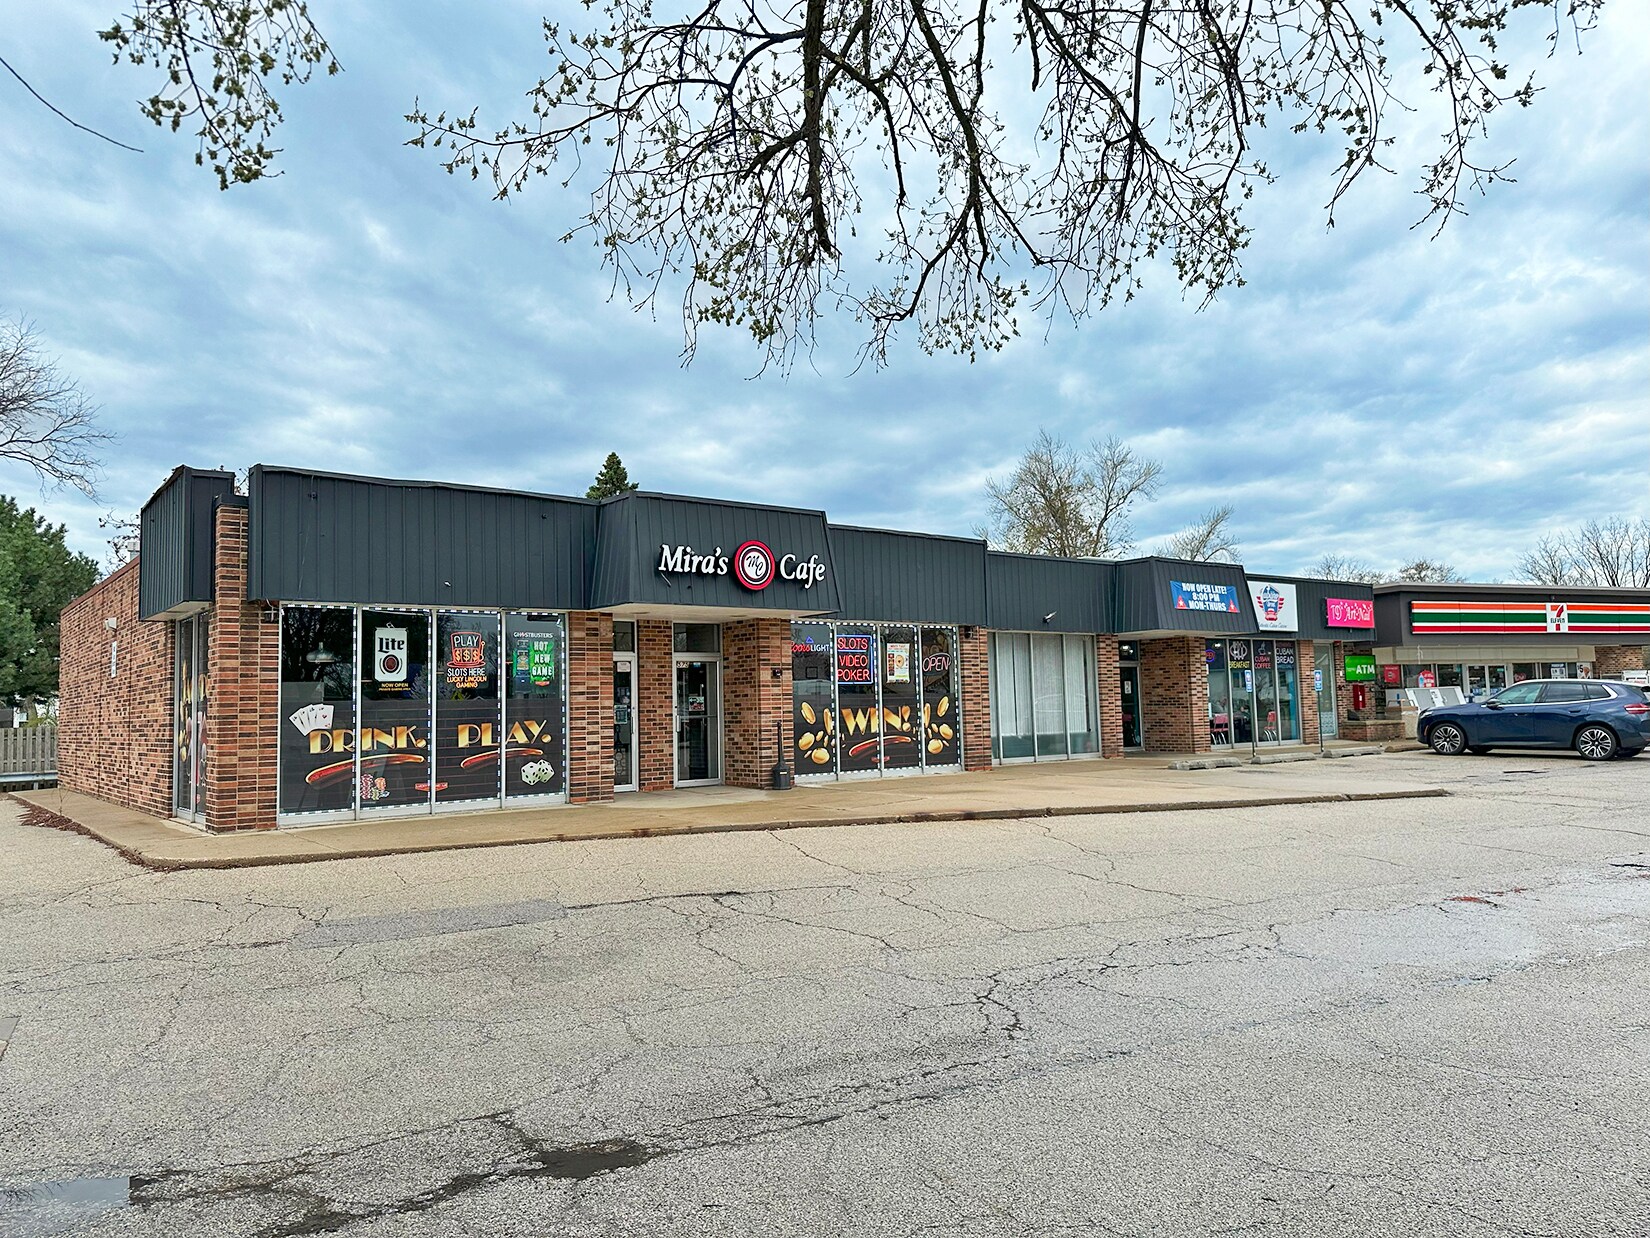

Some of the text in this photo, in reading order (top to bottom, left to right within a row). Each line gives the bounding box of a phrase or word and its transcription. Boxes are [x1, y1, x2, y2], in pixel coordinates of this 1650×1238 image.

[658, 544, 826, 589] Mira's Cafe
[1181, 582, 1228, 595] NOW OPEN LATE!
[1192, 592, 1221, 602] 8:00 PM
[1188, 600, 1227, 611] MON-THURS
[1551, 604, 1564, 632] 7
[378, 637, 405, 654] Lite
[453, 635, 479, 648] PLAY
[533, 641, 549, 651] HOT
[810, 644, 829, 652] LIGHT
[837, 637, 868, 650] SLOTS
[1276, 647, 1294, 655] CUBAN
[534, 653, 551, 664] NEW
[838, 654, 868, 667] VIDEO
[922, 656, 951, 673] OPEN
[1276, 656, 1295, 664] BREAD
[447, 667, 486, 677] SLOTS HERE
[531, 666, 553, 676] GAME
[837, 668, 871, 681] POKER
[1356, 664, 1376, 675] ATM
[840, 705, 911, 736] WIN!
[309, 724, 427, 754] DRINK.
[457, 719, 552, 748] PLAY.
